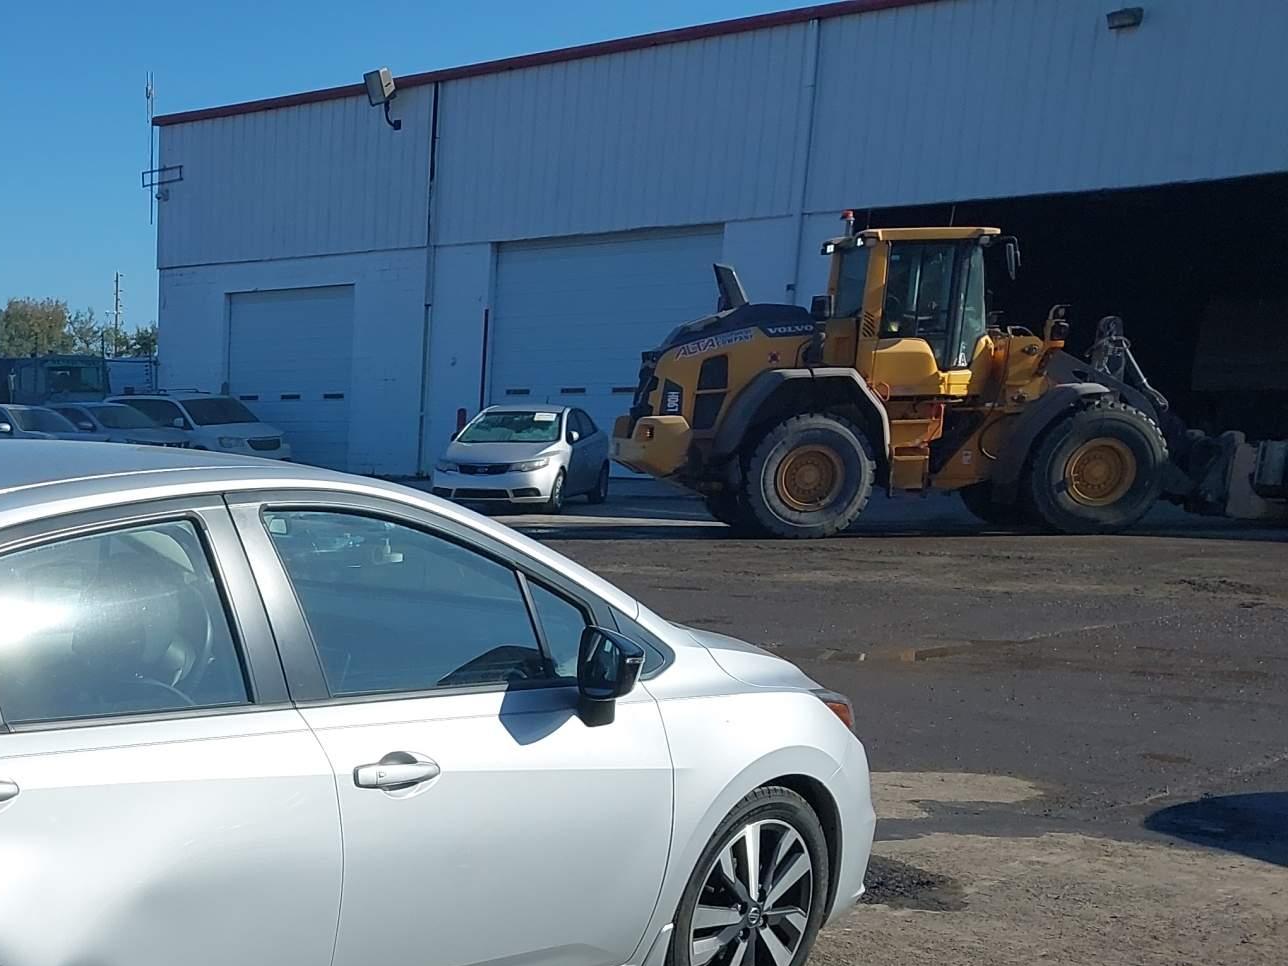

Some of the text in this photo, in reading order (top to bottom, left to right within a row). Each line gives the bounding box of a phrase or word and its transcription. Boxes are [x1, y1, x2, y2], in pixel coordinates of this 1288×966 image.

[768, 325, 814, 334] VOLVO
[675, 336, 716, 359] ALTA
[667, 391, 680, 412] L90H
